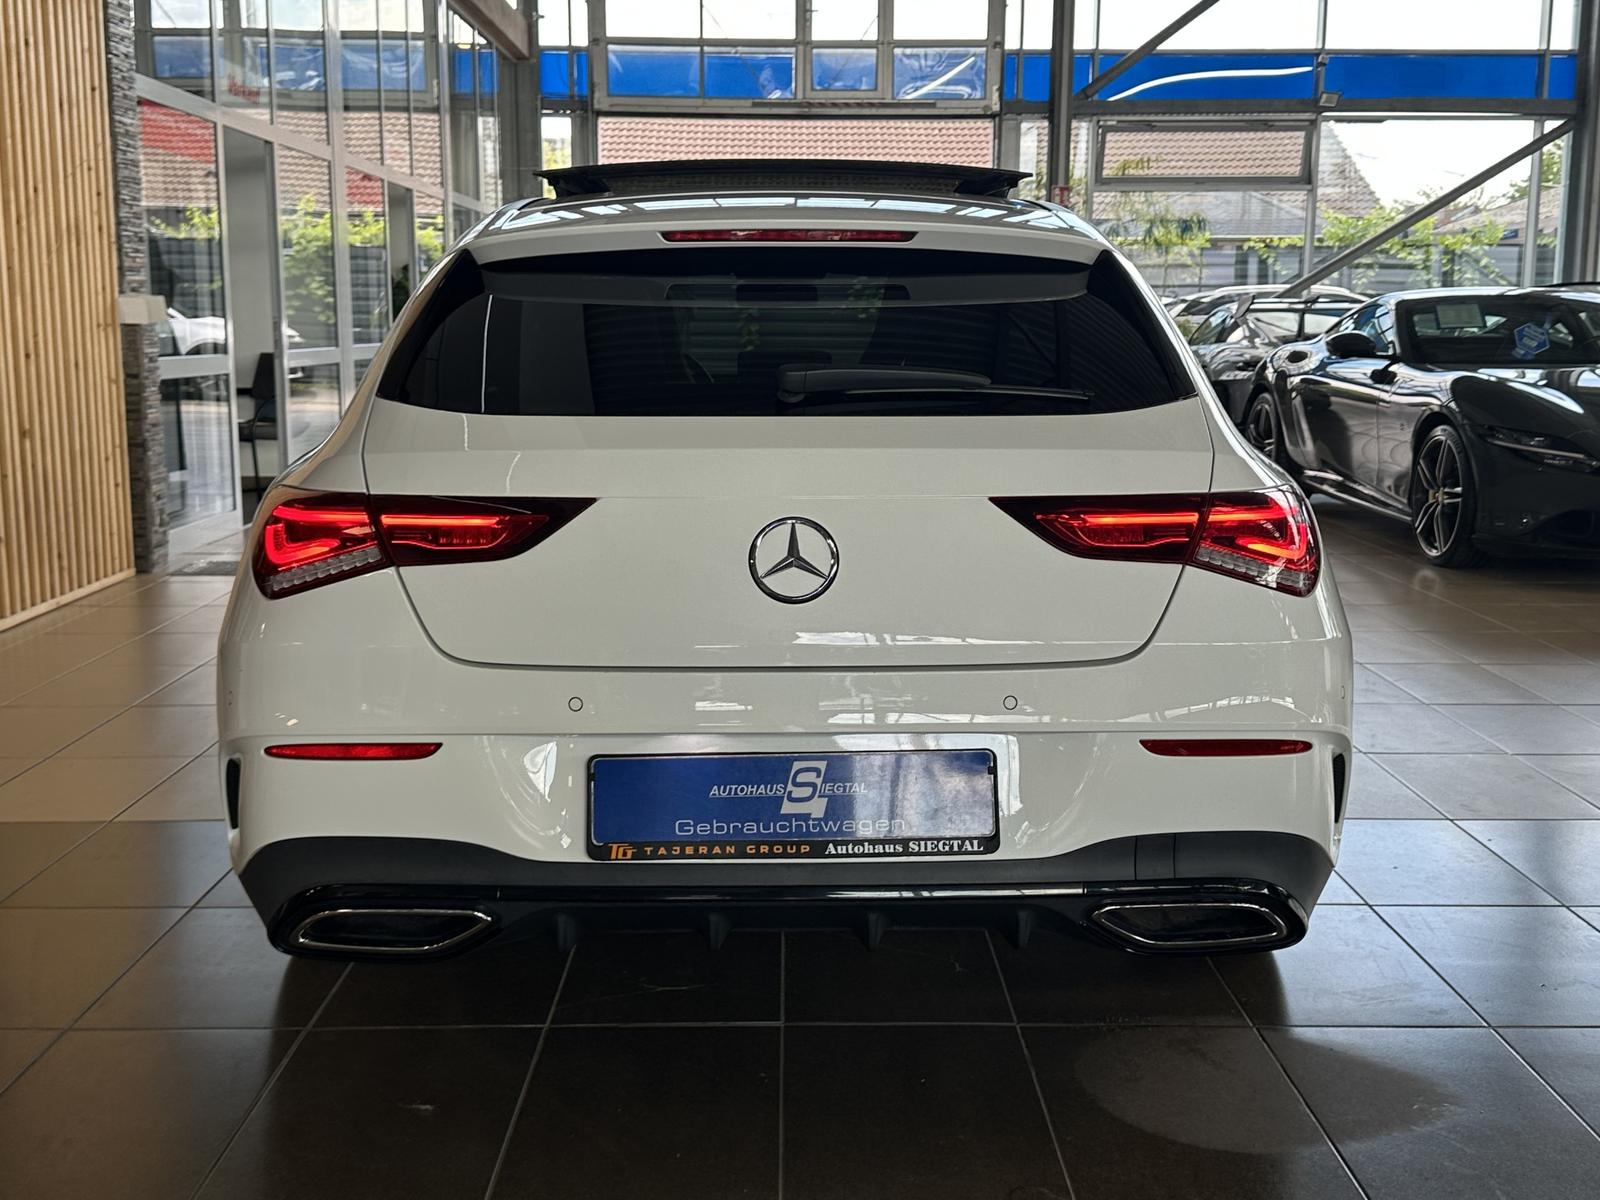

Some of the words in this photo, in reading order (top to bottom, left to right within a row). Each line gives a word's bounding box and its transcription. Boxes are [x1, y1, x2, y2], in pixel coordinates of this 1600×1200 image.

[709, 784, 785, 797] AUTOHAUS
[674, 817, 905, 836] Gebrauchtwagen
[644, 845, 736, 856] TAJERAN
[746, 844, 811, 854] GROUP
[824, 842, 904, 855] Autohaus
[908, 839, 984, 853] SIEGTAL
